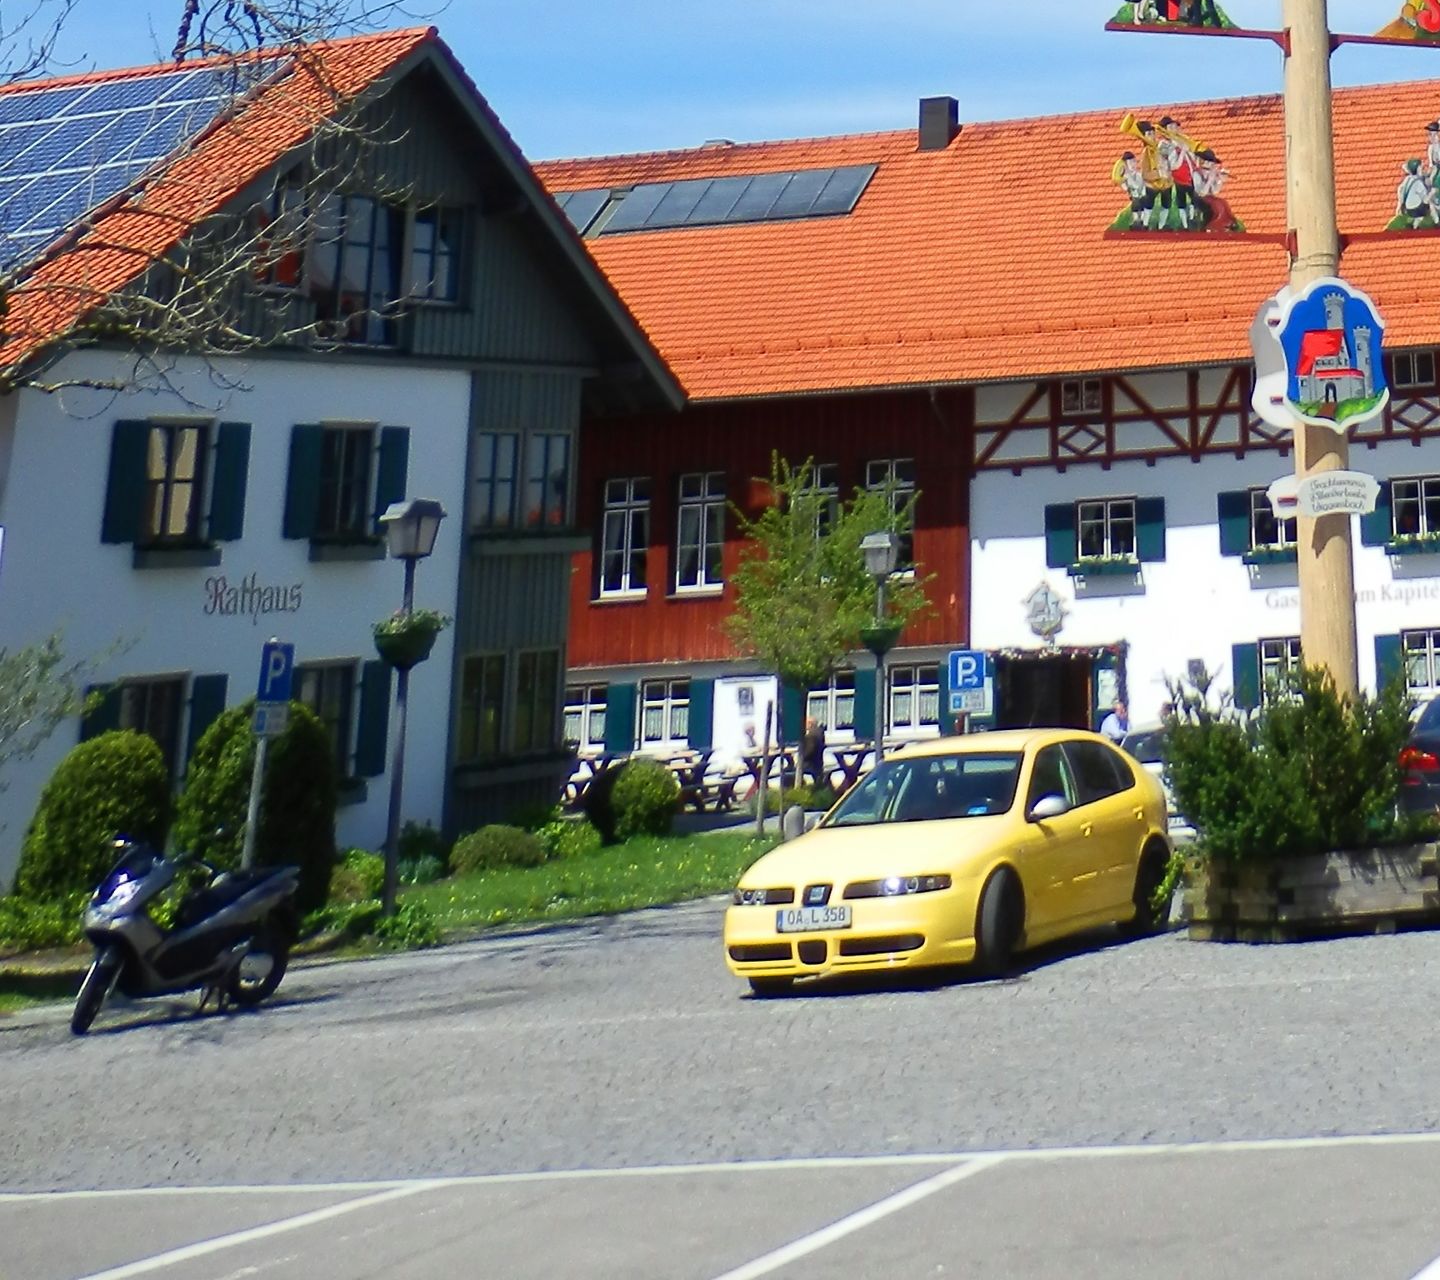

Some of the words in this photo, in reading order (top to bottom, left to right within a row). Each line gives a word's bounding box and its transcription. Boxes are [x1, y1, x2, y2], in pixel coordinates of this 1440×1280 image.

[203, 572, 304, 627] Rathaus
[957, 655, 977, 687] P
[822, 906, 846, 923] 358
